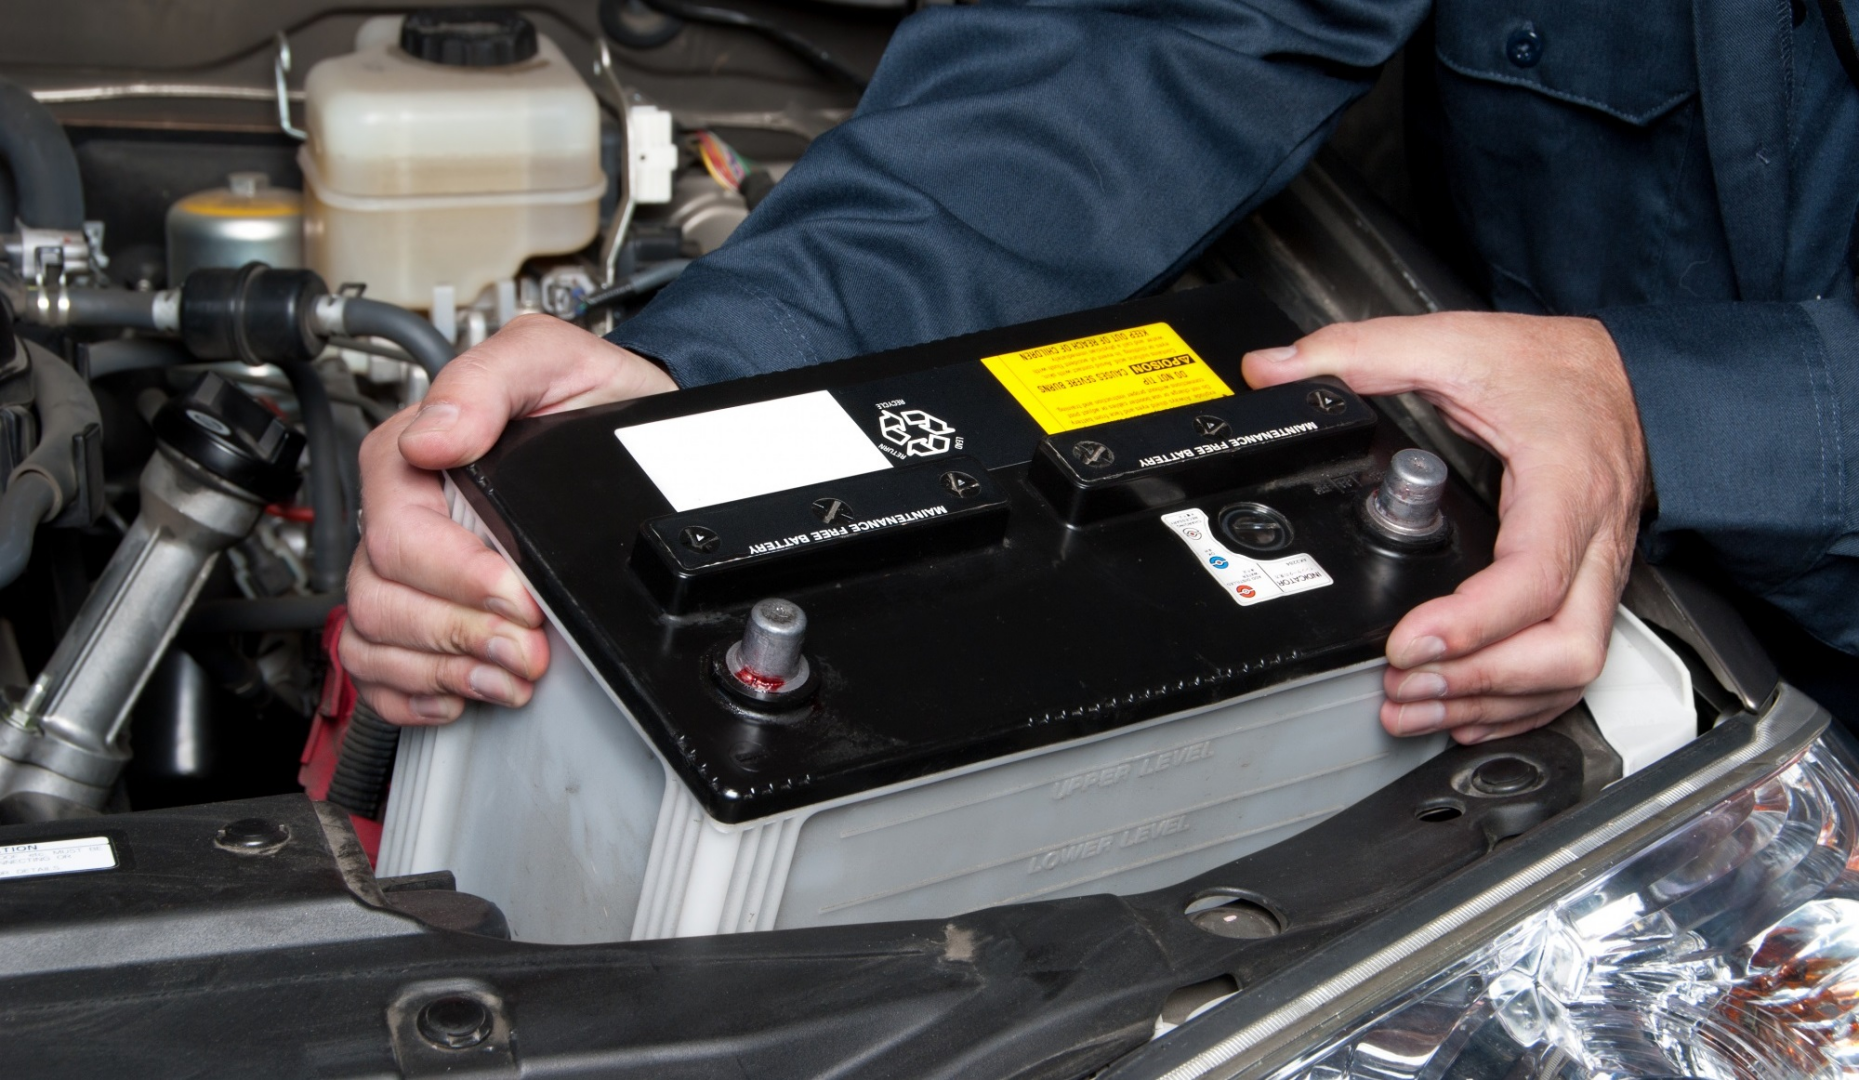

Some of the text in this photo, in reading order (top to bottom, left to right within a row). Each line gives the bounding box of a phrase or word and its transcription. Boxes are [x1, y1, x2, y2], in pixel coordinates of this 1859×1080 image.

[1019, 329, 1149, 361] KEEP OUT OF REACH OF CHILDREN
[1095, 361, 1112, 369] Avoid
[1037, 357, 1181, 394] POISON CAUSES SEVERE BURNS
[1143, 370, 1188, 386] DO NOT TIP
[1127, 389, 1146, 397] proper
[1148, 385, 1169, 393] without
[875, 399, 906, 410] RECYCLE
[1129, 397, 1152, 405] booster
[1170, 396, 1191, 404] Always
[954, 436, 964, 450] LEAD
[1138, 421, 1318, 467] MAINTENANCE FREE BATTERY
[878, 443, 907, 460] RETURN
[748, 505, 948, 554] MAINTENANCE FREE BATTERY
[1277, 571, 1322, 586] INDICATOR
[1053, 741, 1215, 800] UPPER LEVEL
[0, 845, 37, 853] TION
[1027, 815, 1190, 874] LOWER LEVEL
